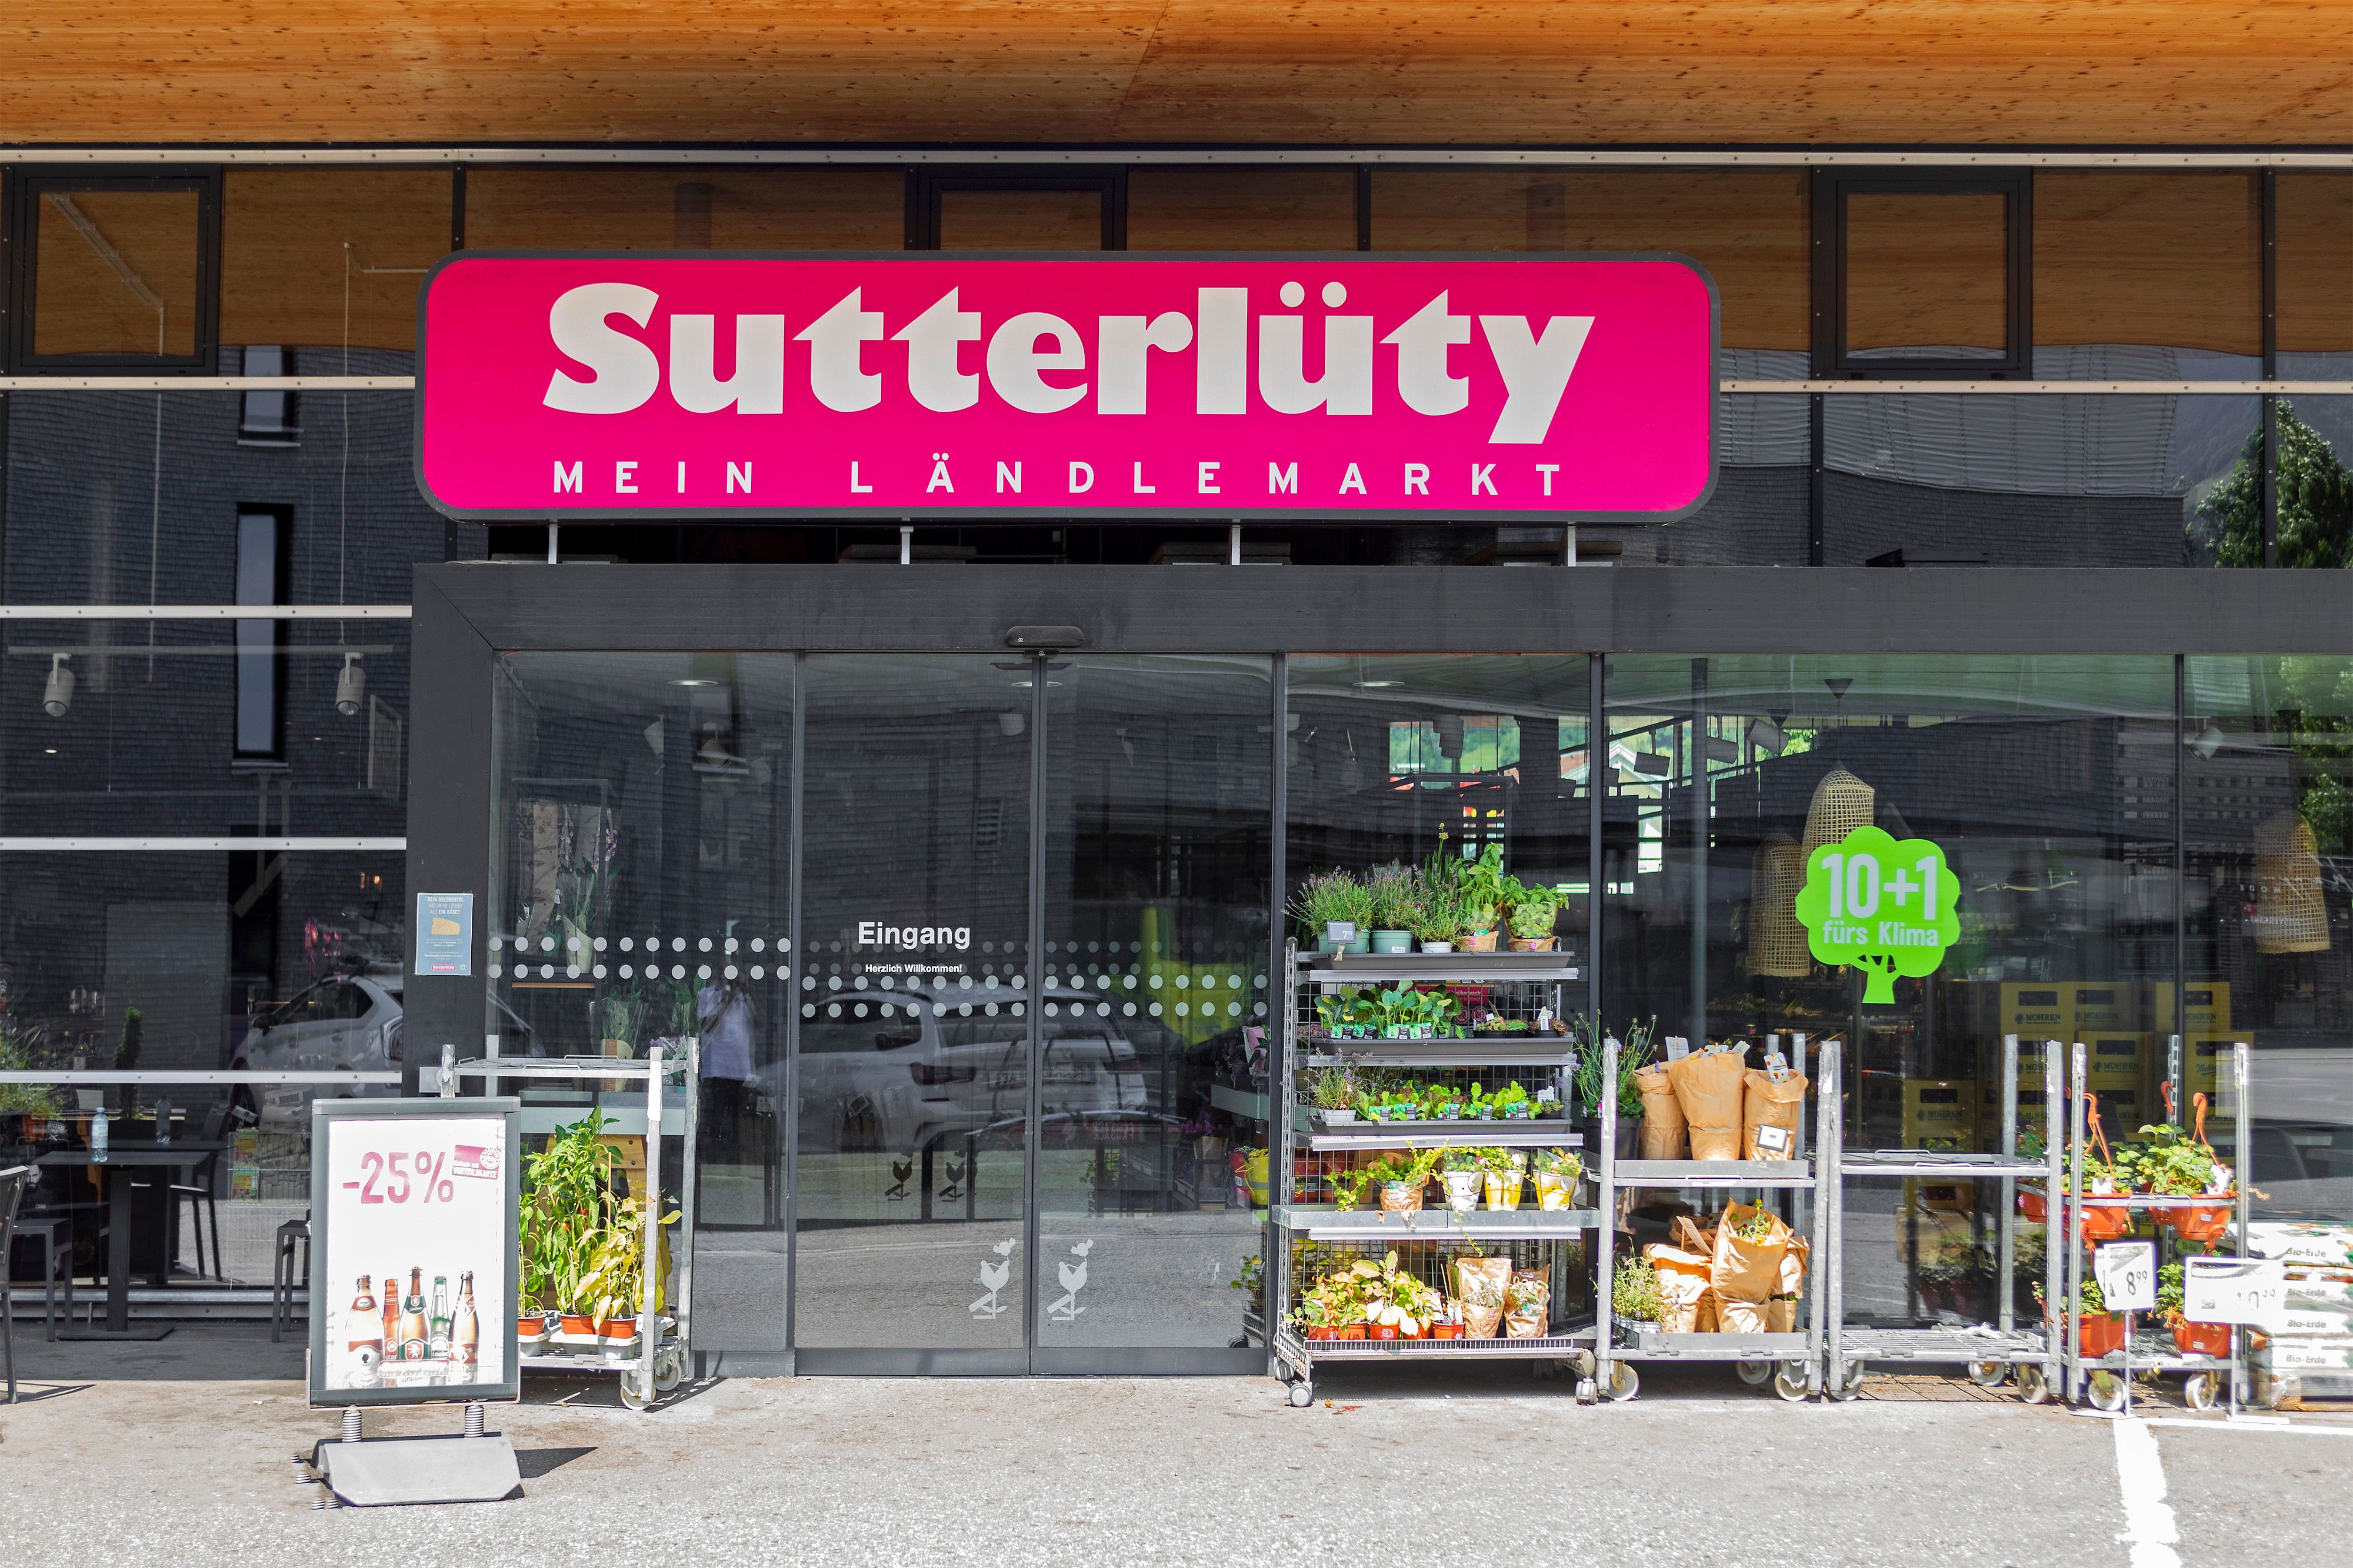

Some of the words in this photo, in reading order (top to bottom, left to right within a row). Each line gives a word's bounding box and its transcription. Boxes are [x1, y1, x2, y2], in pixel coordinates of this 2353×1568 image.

[542, 281, 1595, 445] Sutterlüty
[553, 461, 753, 494] MEIN
[851, 452, 1561, 496] LÄNDLEMARKT
[1822, 853, 1937, 920] 10+1
[858, 922, 970, 950] Eingang
[1822, 920, 1868, 945] fürs
[1878, 922, 1939, 946] Klima
[865, 964, 902, 973] Herzlich
[904, 964, 962, 973] Willkommen!
[343, 1151, 453, 1205] -25%
[2286, 1247, 2327, 1257] Bio-Erde
[2287, 1288, 2327, 1296] Bio-Erde
[2287, 1319, 2327, 1328] Bio-Erde
[2286, 1355, 2326, 1364] Bio-Erde
